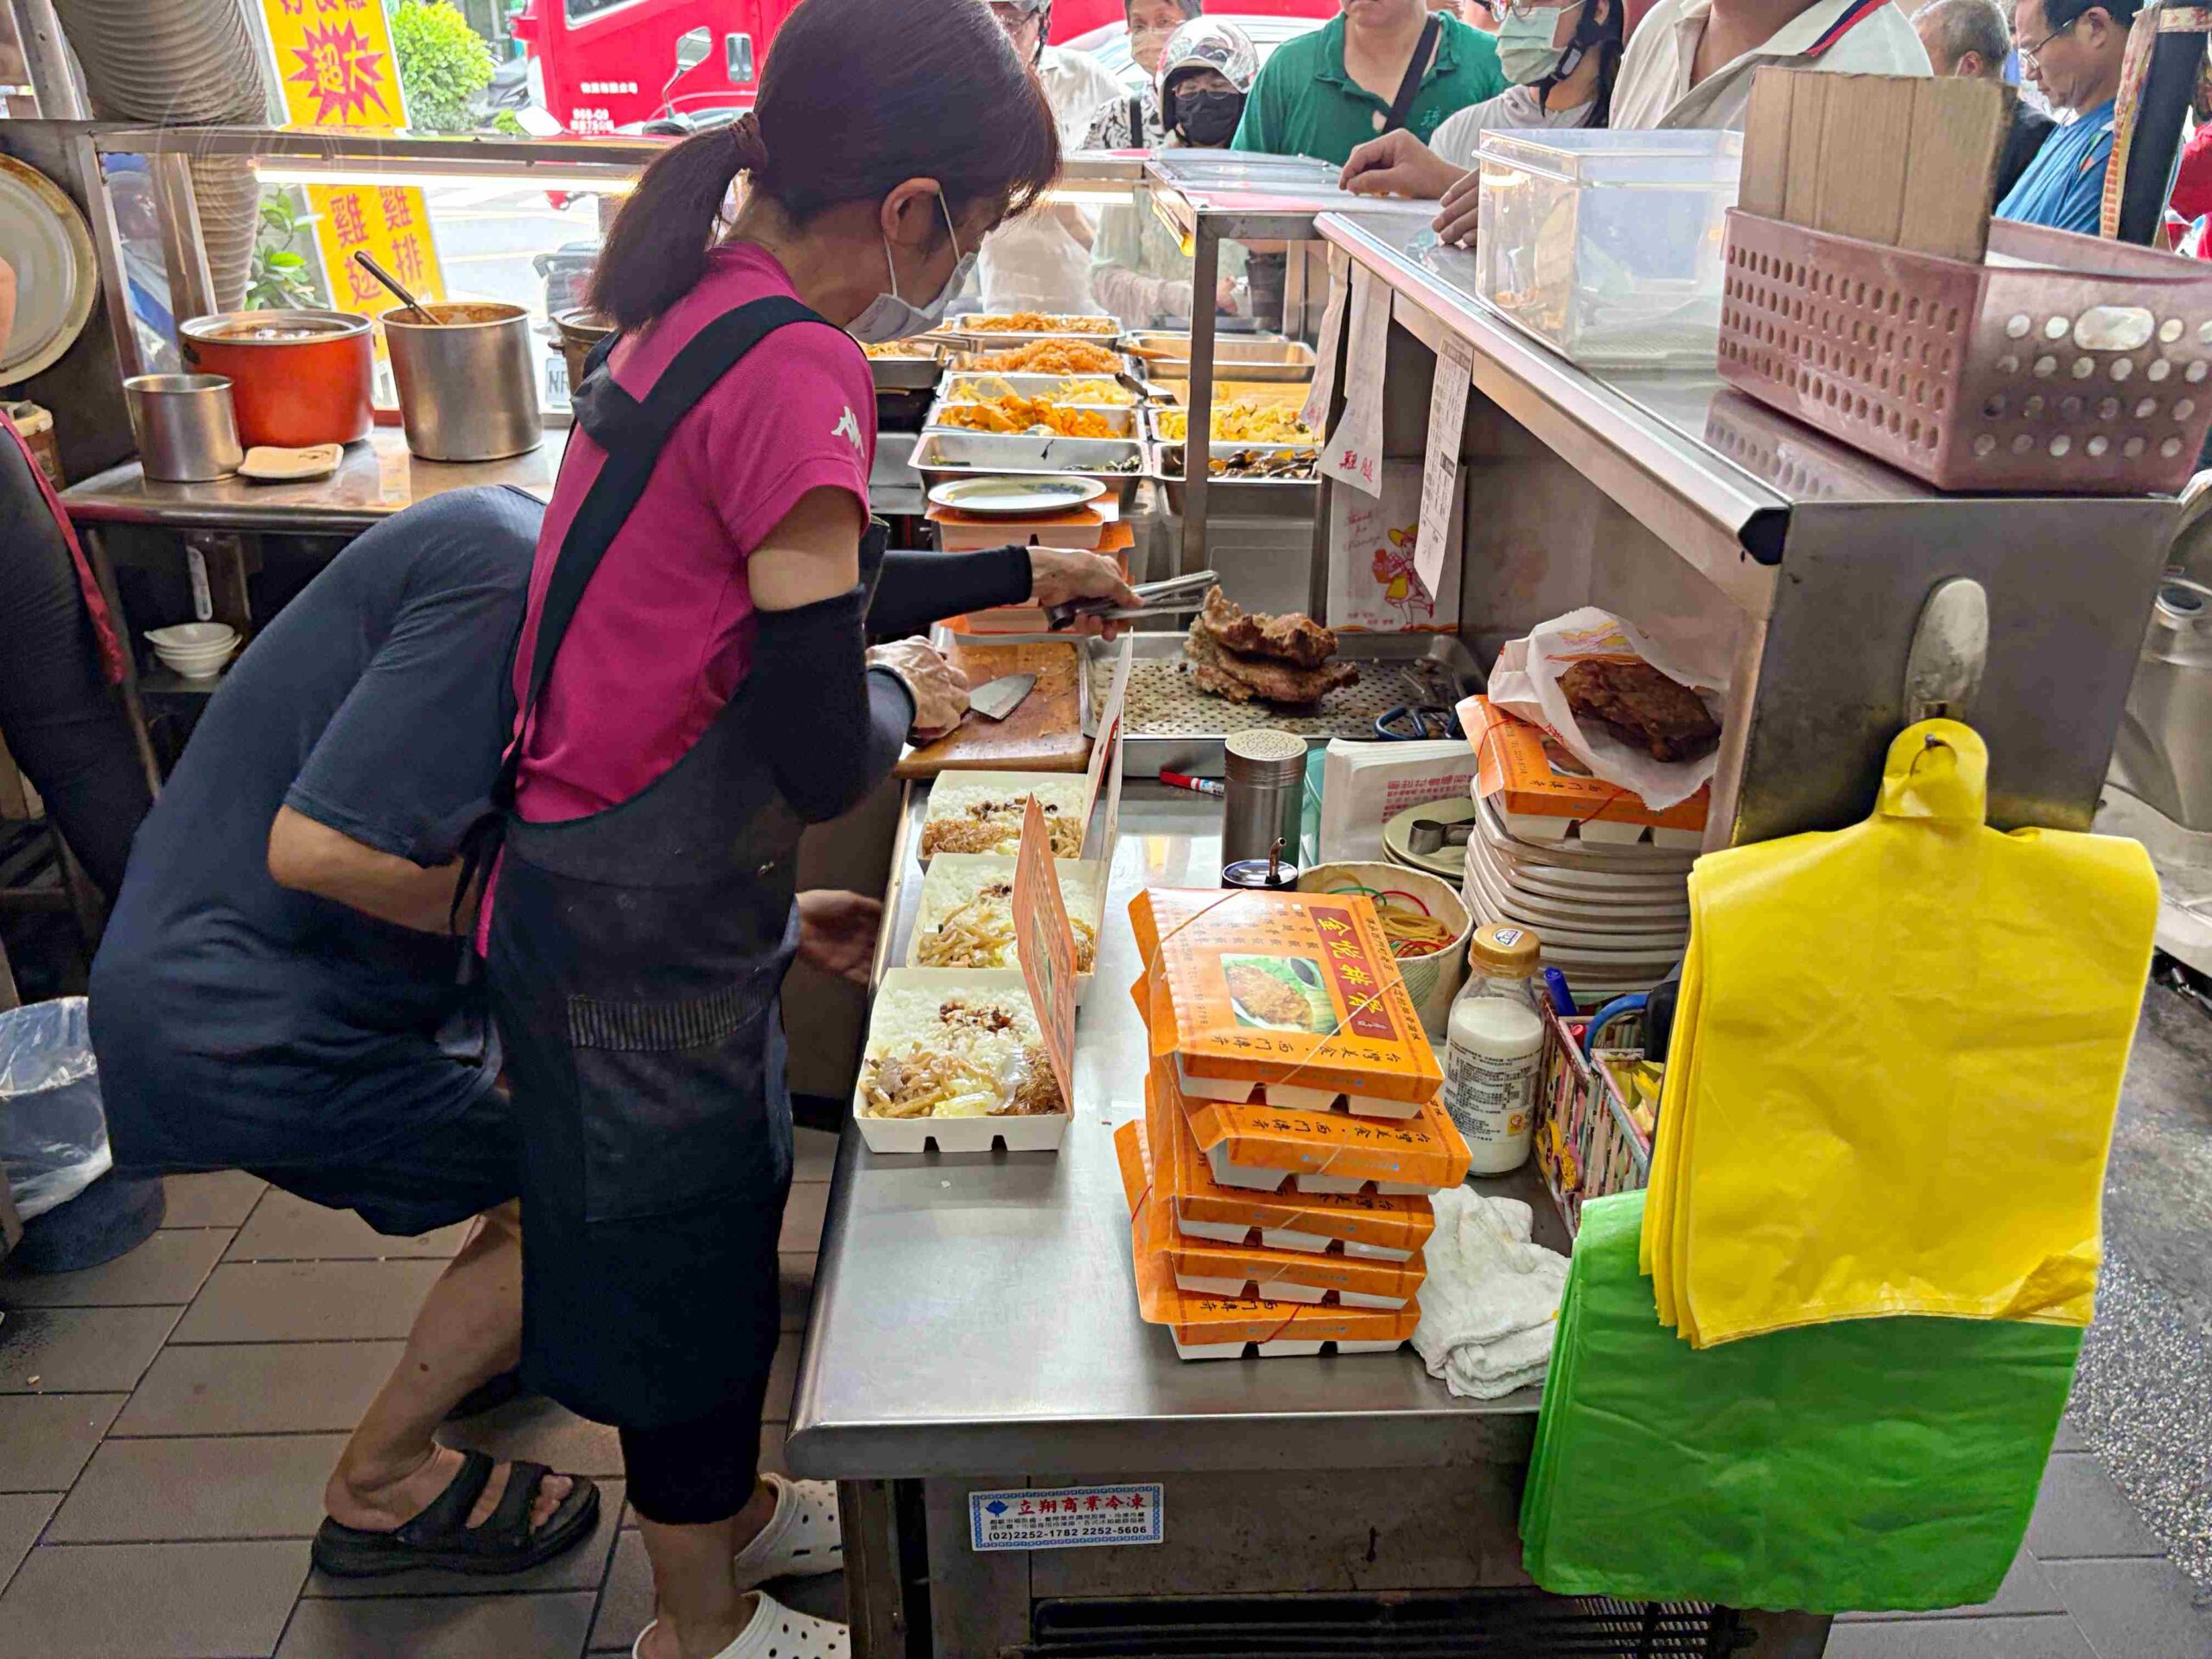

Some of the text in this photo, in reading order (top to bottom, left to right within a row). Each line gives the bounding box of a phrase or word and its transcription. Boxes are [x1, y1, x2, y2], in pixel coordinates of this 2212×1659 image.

[312, 41, 373, 94] 超大
[1317, 917, 1384, 1014] 金悅排骨
[1018, 1492, 1147, 1516] 立翔商業冷凍
[988, 1525, 1147, 1541] (02)2252-1782 2252-5606
